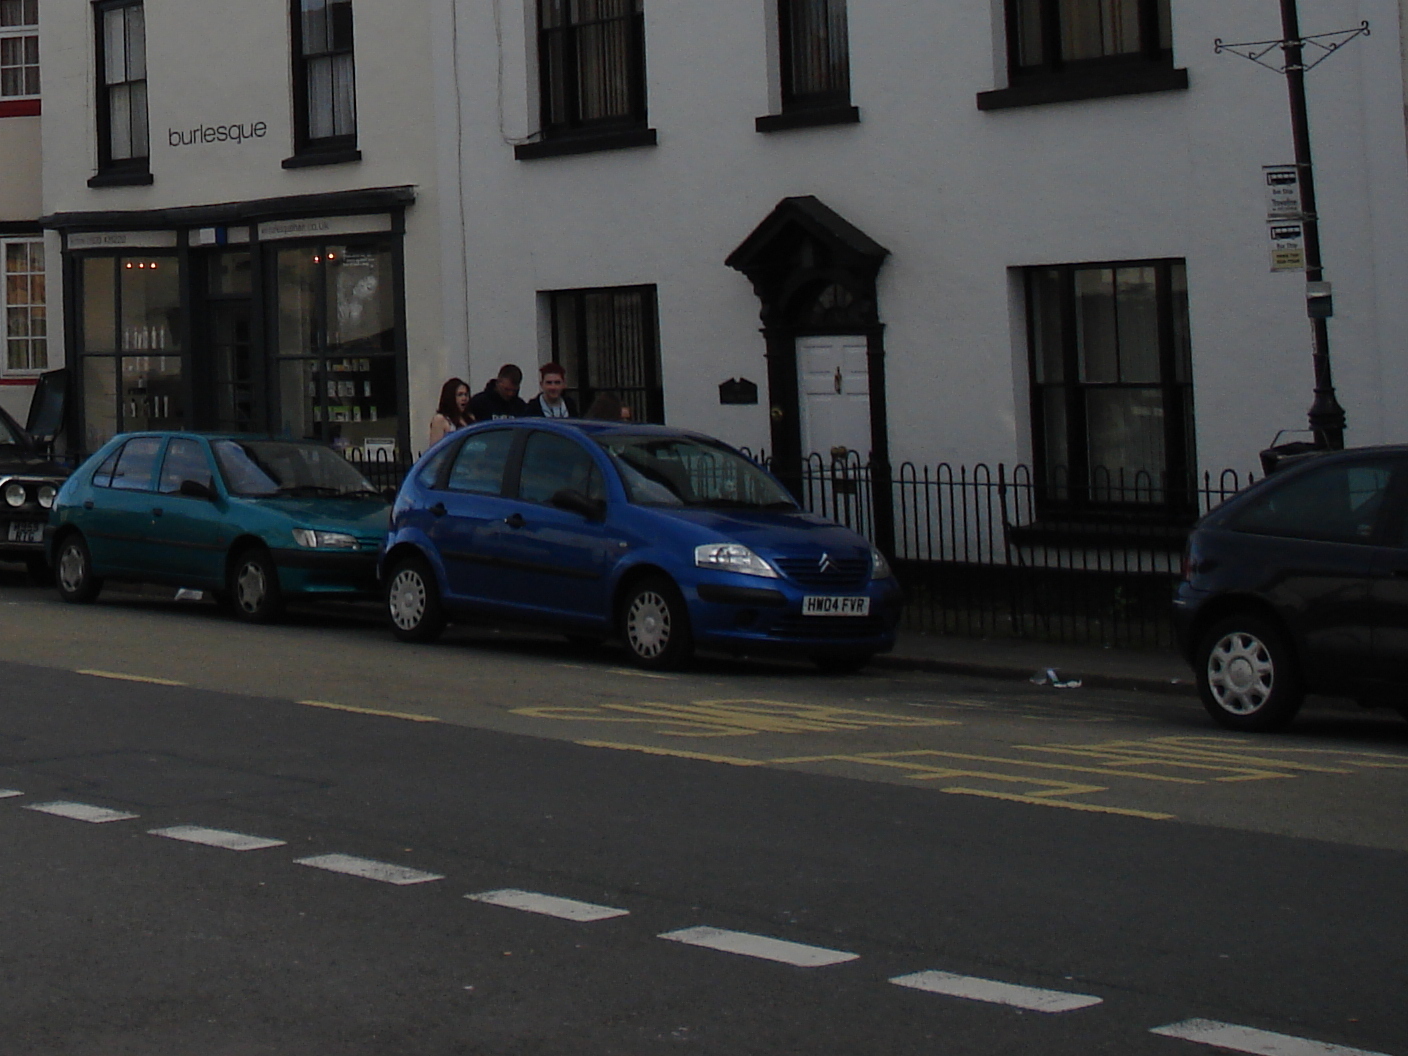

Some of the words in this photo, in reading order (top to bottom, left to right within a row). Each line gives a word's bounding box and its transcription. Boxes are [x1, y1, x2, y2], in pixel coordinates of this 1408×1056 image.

[168, 121, 268, 148] burlesque
[808, 597, 839, 612] HW04
[842, 598, 865, 613] FVR
